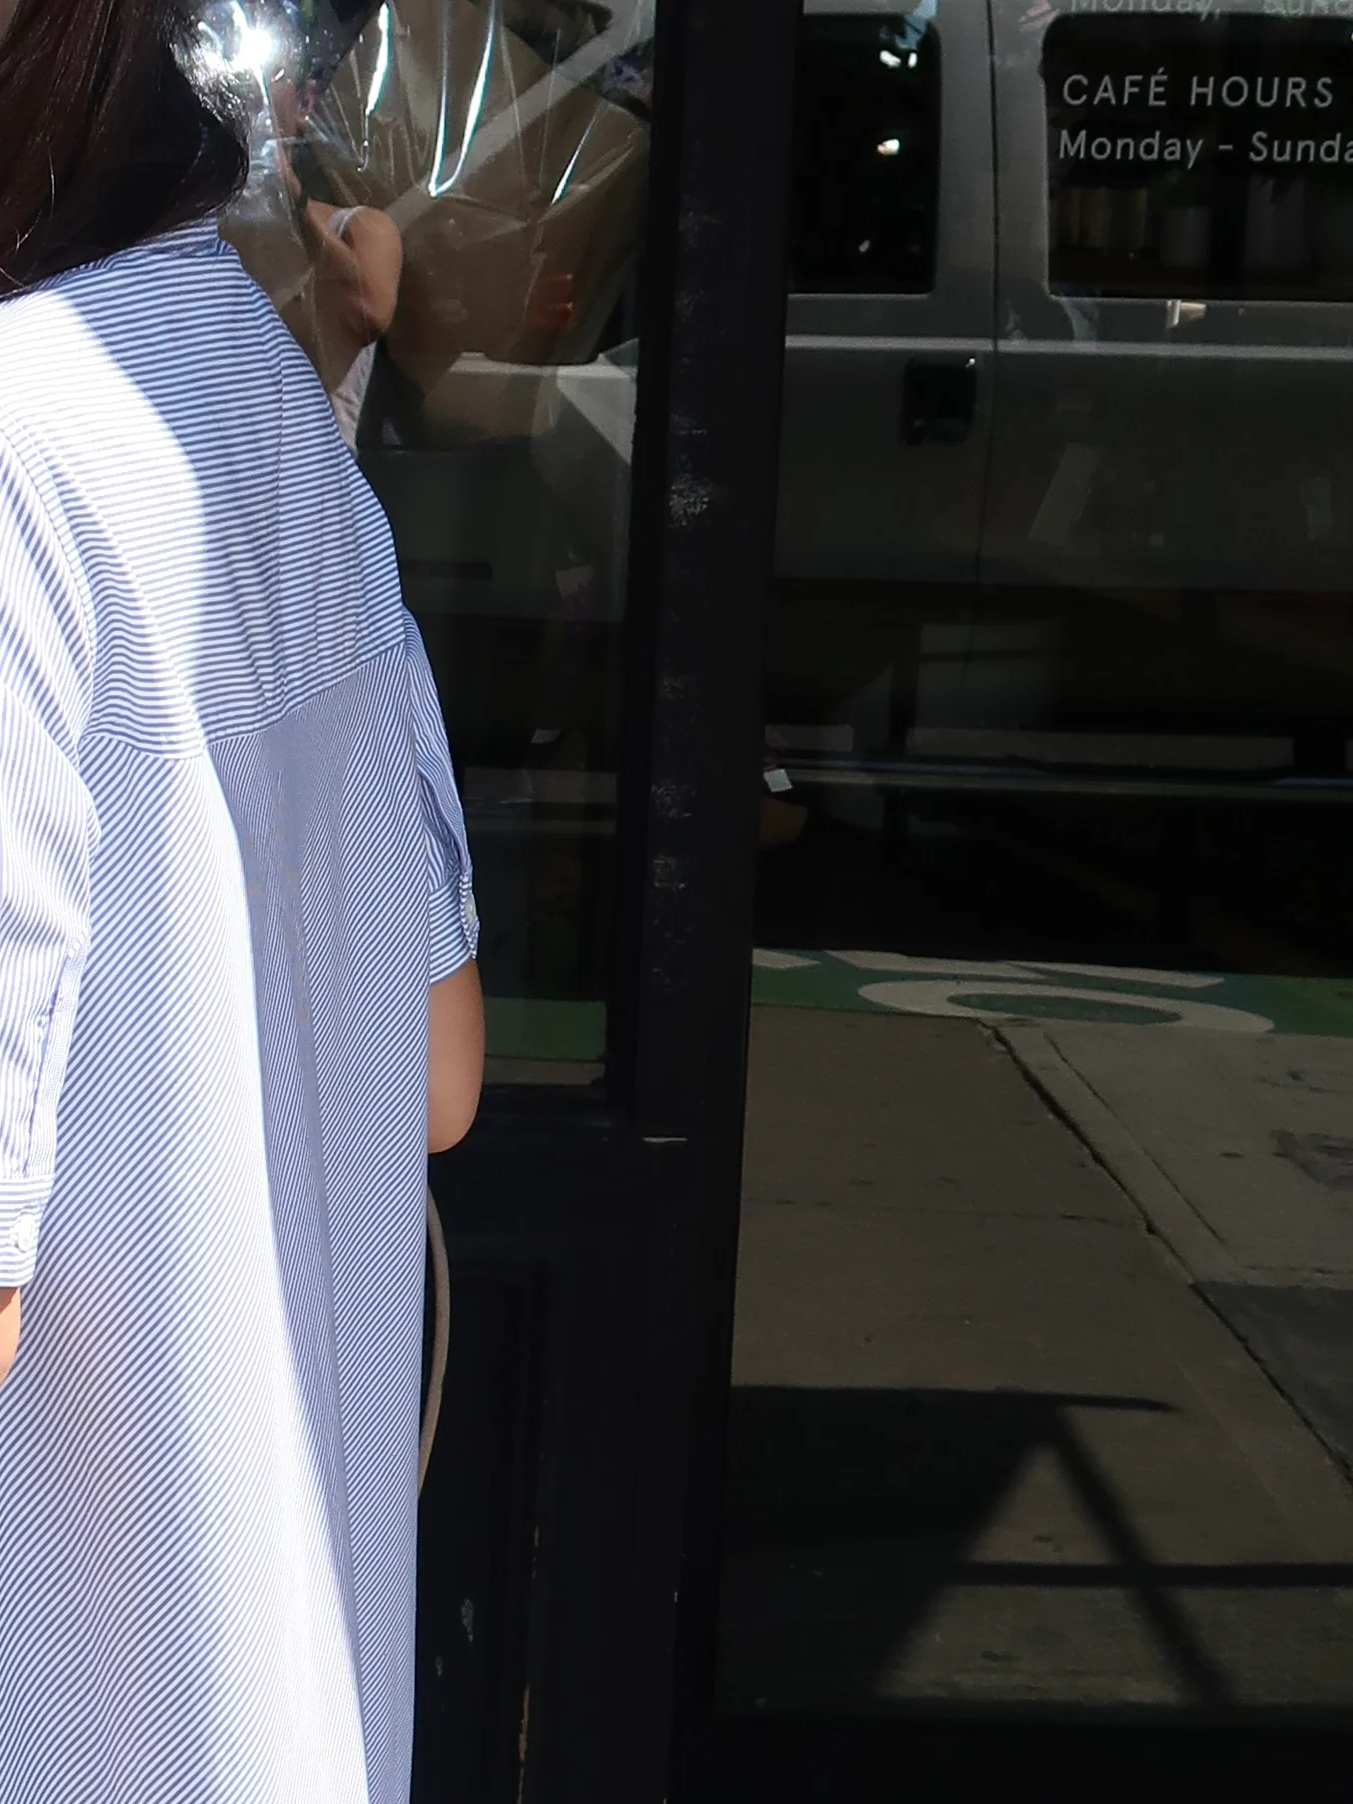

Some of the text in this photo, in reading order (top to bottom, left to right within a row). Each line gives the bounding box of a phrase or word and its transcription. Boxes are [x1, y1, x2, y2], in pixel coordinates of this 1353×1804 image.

[1062, 66, 1335, 109] CAFÉ HOURS
[1058, 128, 1204, 170] Monday
